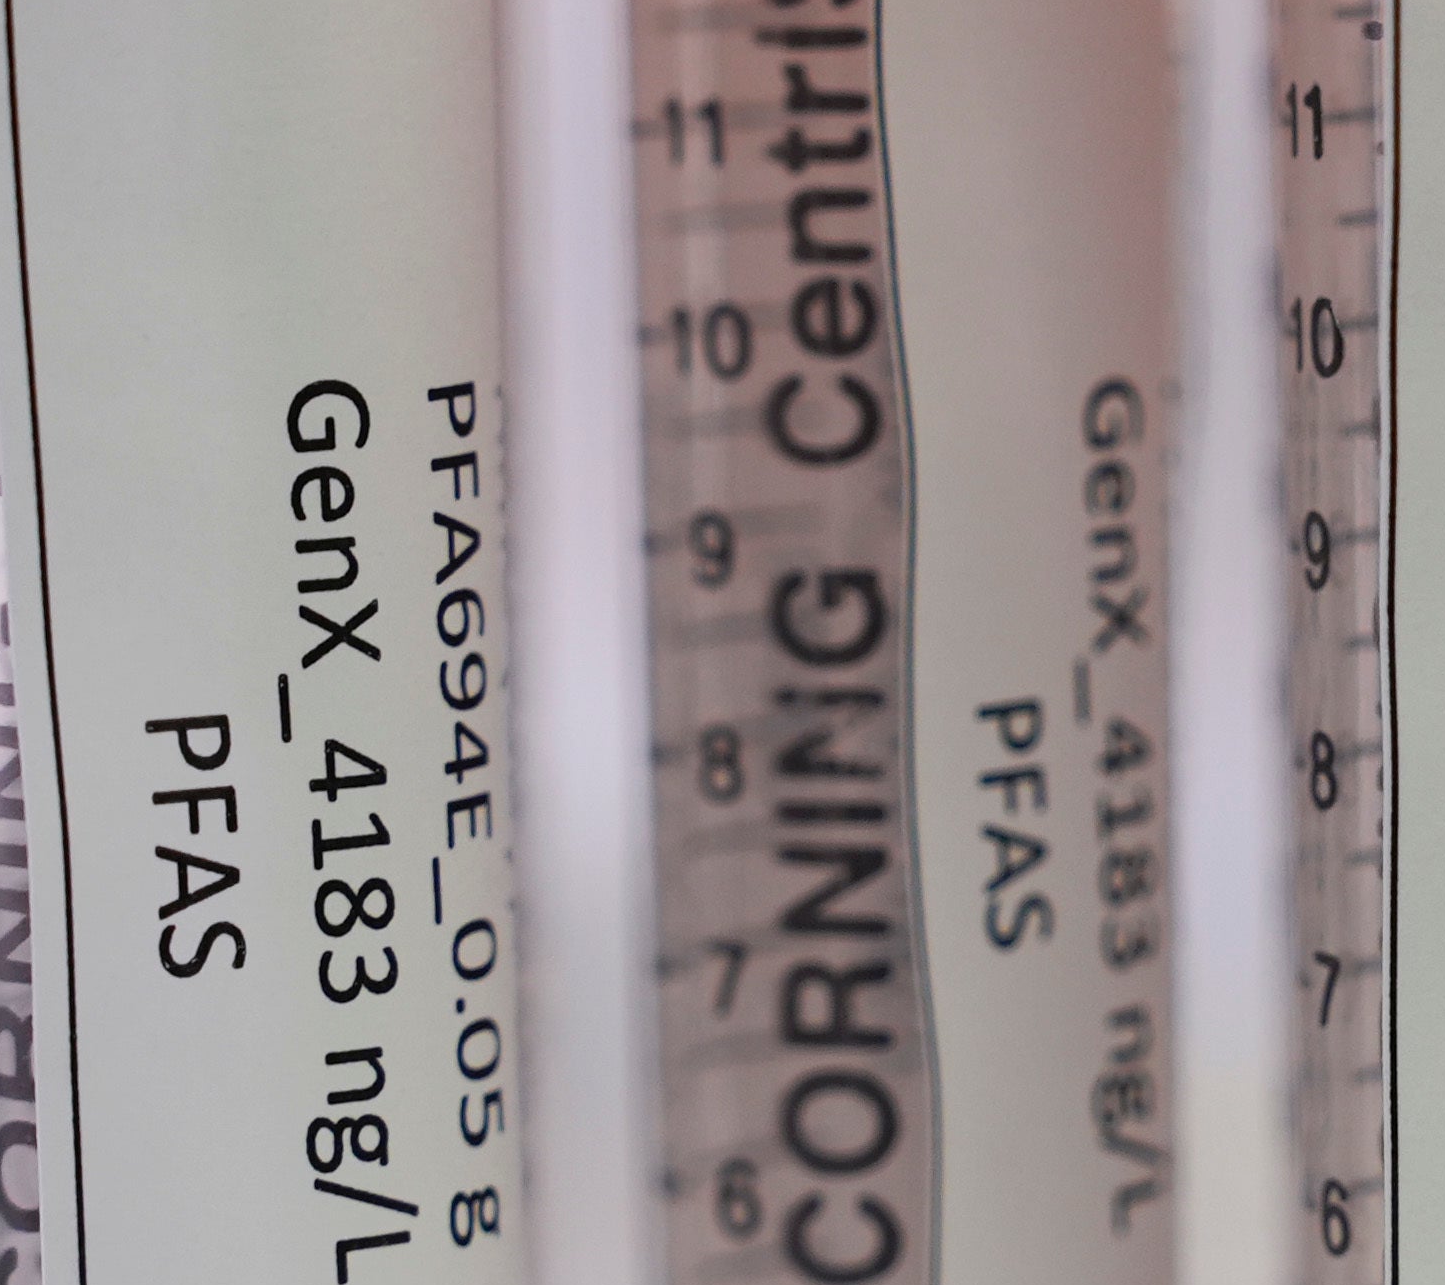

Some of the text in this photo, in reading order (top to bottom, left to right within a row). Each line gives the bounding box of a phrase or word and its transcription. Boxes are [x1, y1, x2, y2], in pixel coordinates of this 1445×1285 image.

[662, 98, 726, 166] 11
[1285, 84, 1325, 160] 11
[666, 304, 753, 382] 10
[1291, 297, 1343, 379] 10
[686, 510, 733, 589] 9
[1302, 512, 1331, 592] 9
[698, 725, 743, 804] 8
[1309, 732, 1338, 810] 8
[145, 715, 246, 977] PFAS
[277, 379, 419, 1283] GenX_4183 ng/L
[426, 381, 505, 1248] PFA694E_0.05 g
[975, 697, 1055, 953] PFAS
[707, 940, 749, 1017] 7
[1314, 951, 1341, 1026] 7
[716, 1157, 762, 1242] 6
[1321, 1179, 1352, 1256] 6
